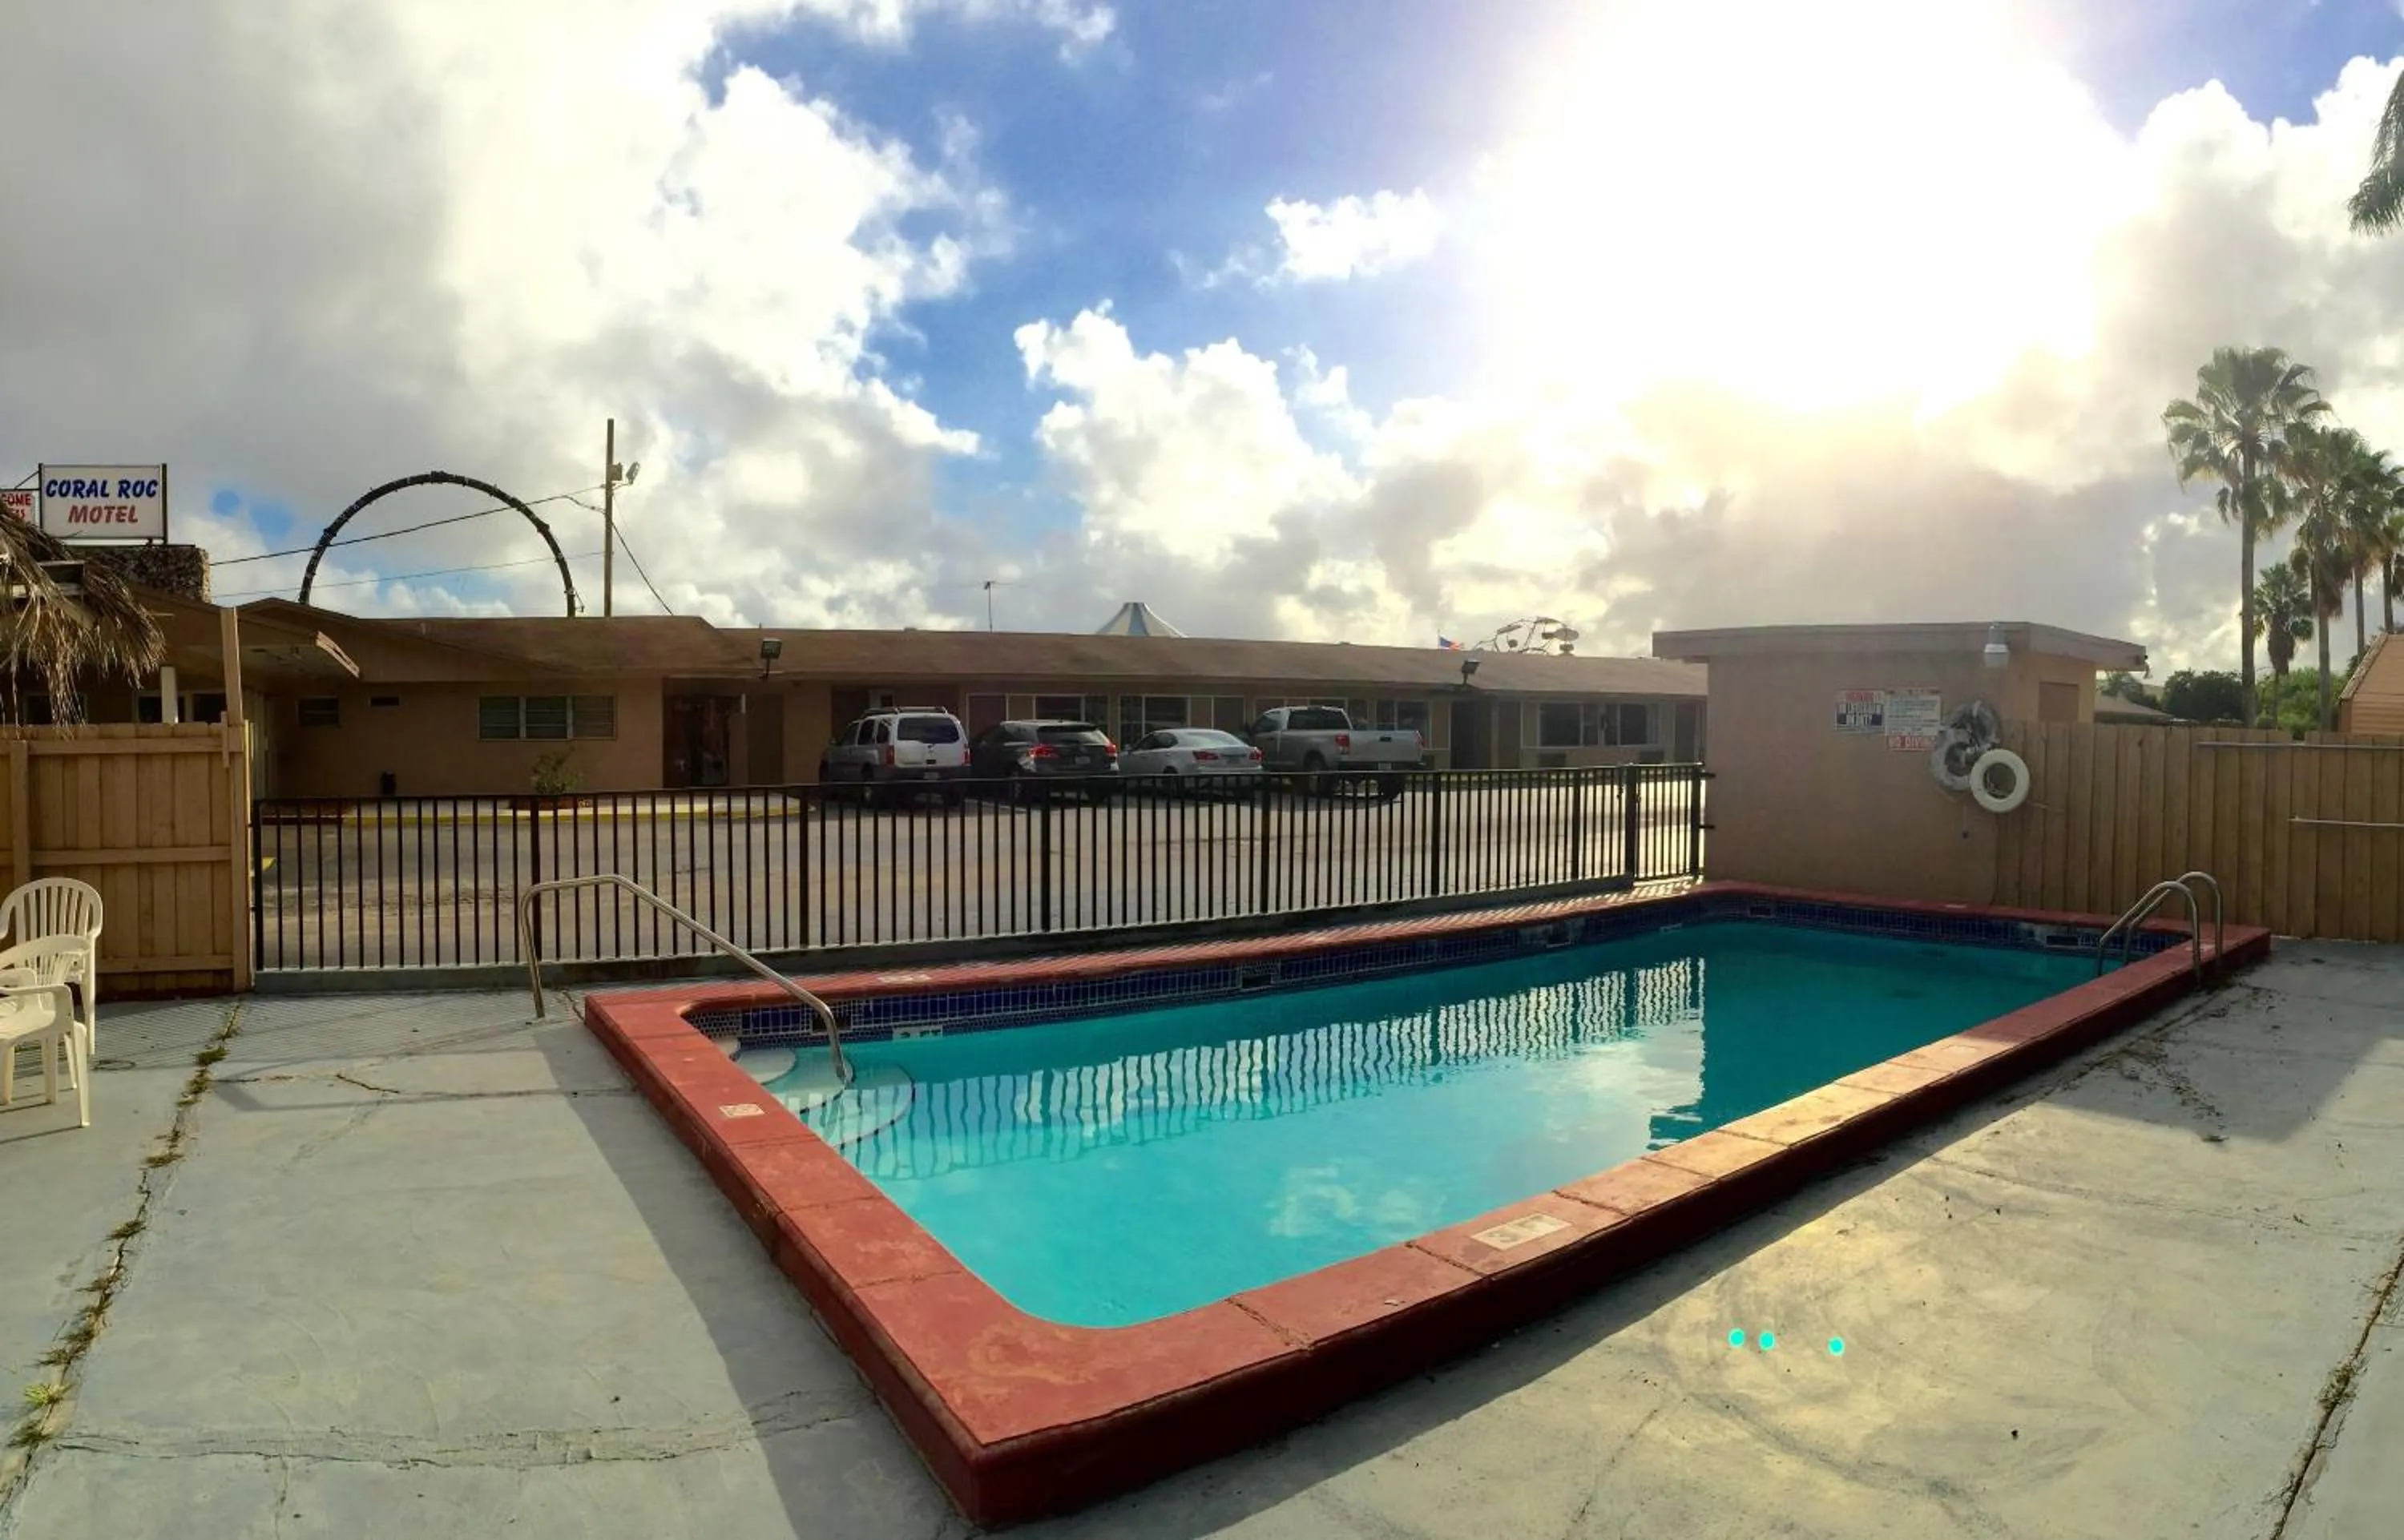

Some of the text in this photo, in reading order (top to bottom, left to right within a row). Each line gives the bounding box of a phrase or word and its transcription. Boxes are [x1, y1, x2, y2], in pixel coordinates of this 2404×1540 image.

[46, 478, 159, 499] CORAL ROC
[67, 505, 139, 523] MOTEL
